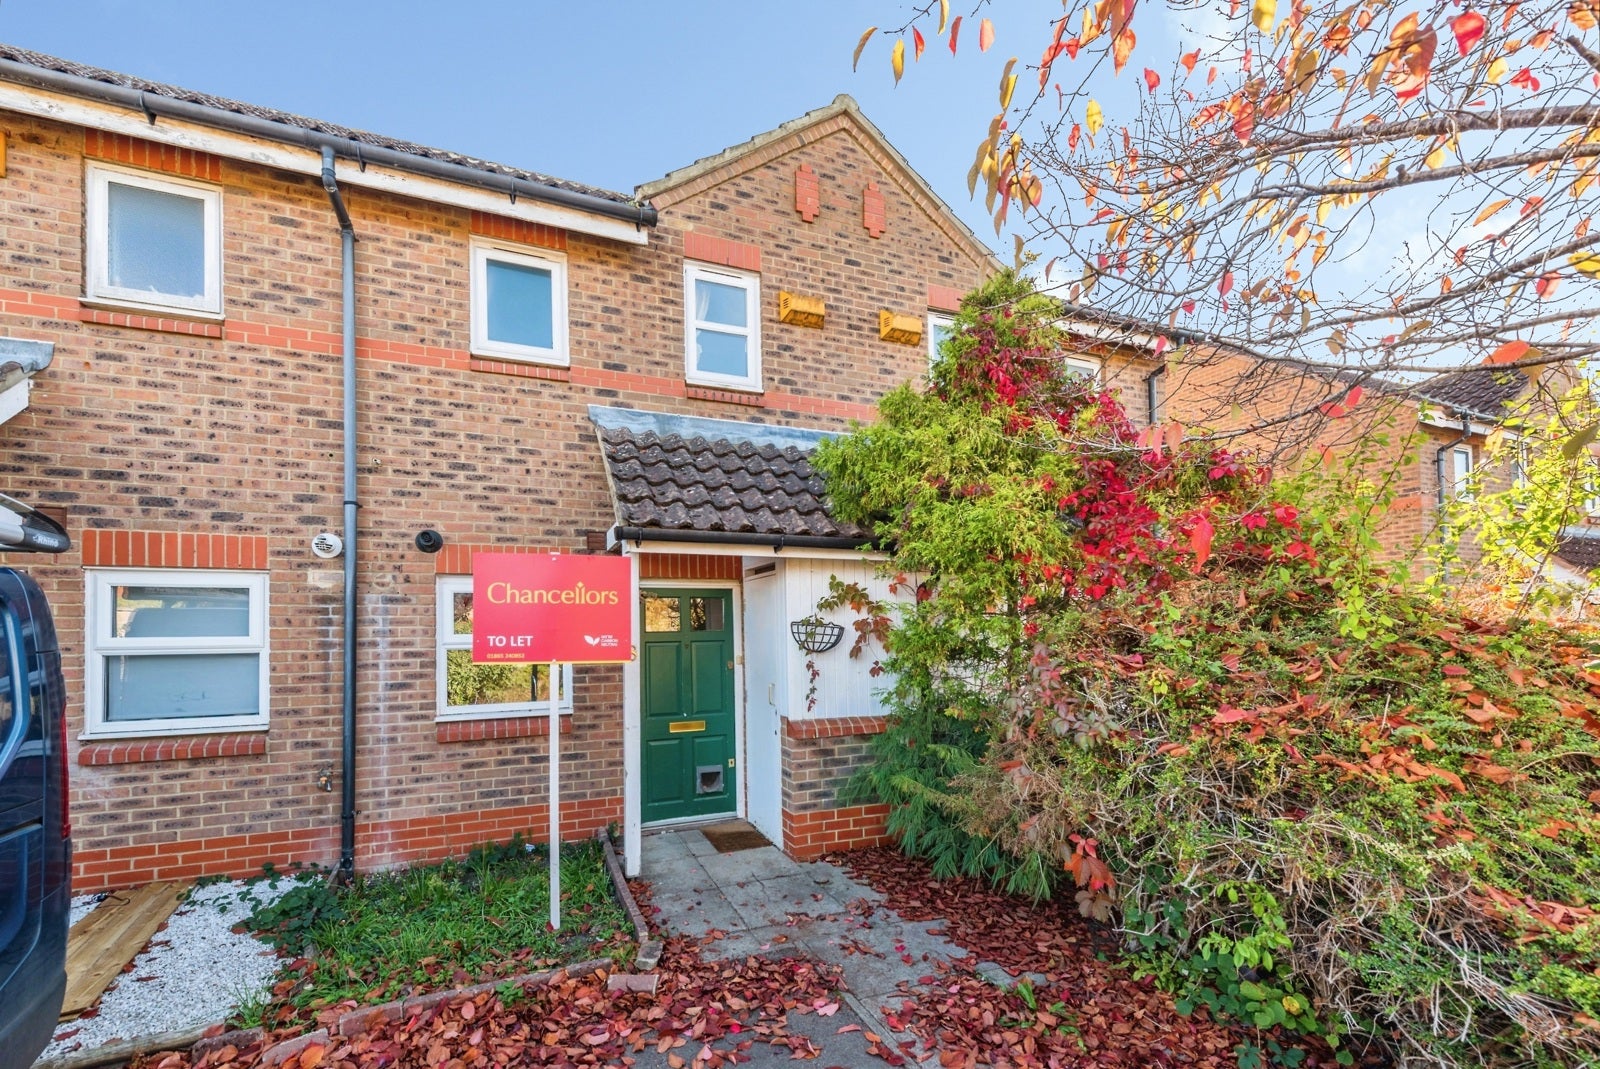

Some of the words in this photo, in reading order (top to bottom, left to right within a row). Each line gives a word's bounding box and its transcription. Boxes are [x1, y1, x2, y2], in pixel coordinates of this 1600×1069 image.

[487, 581, 619, 605] Chancellors
[487, 635, 506, 647] TO
[510, 635, 534, 647] LET
